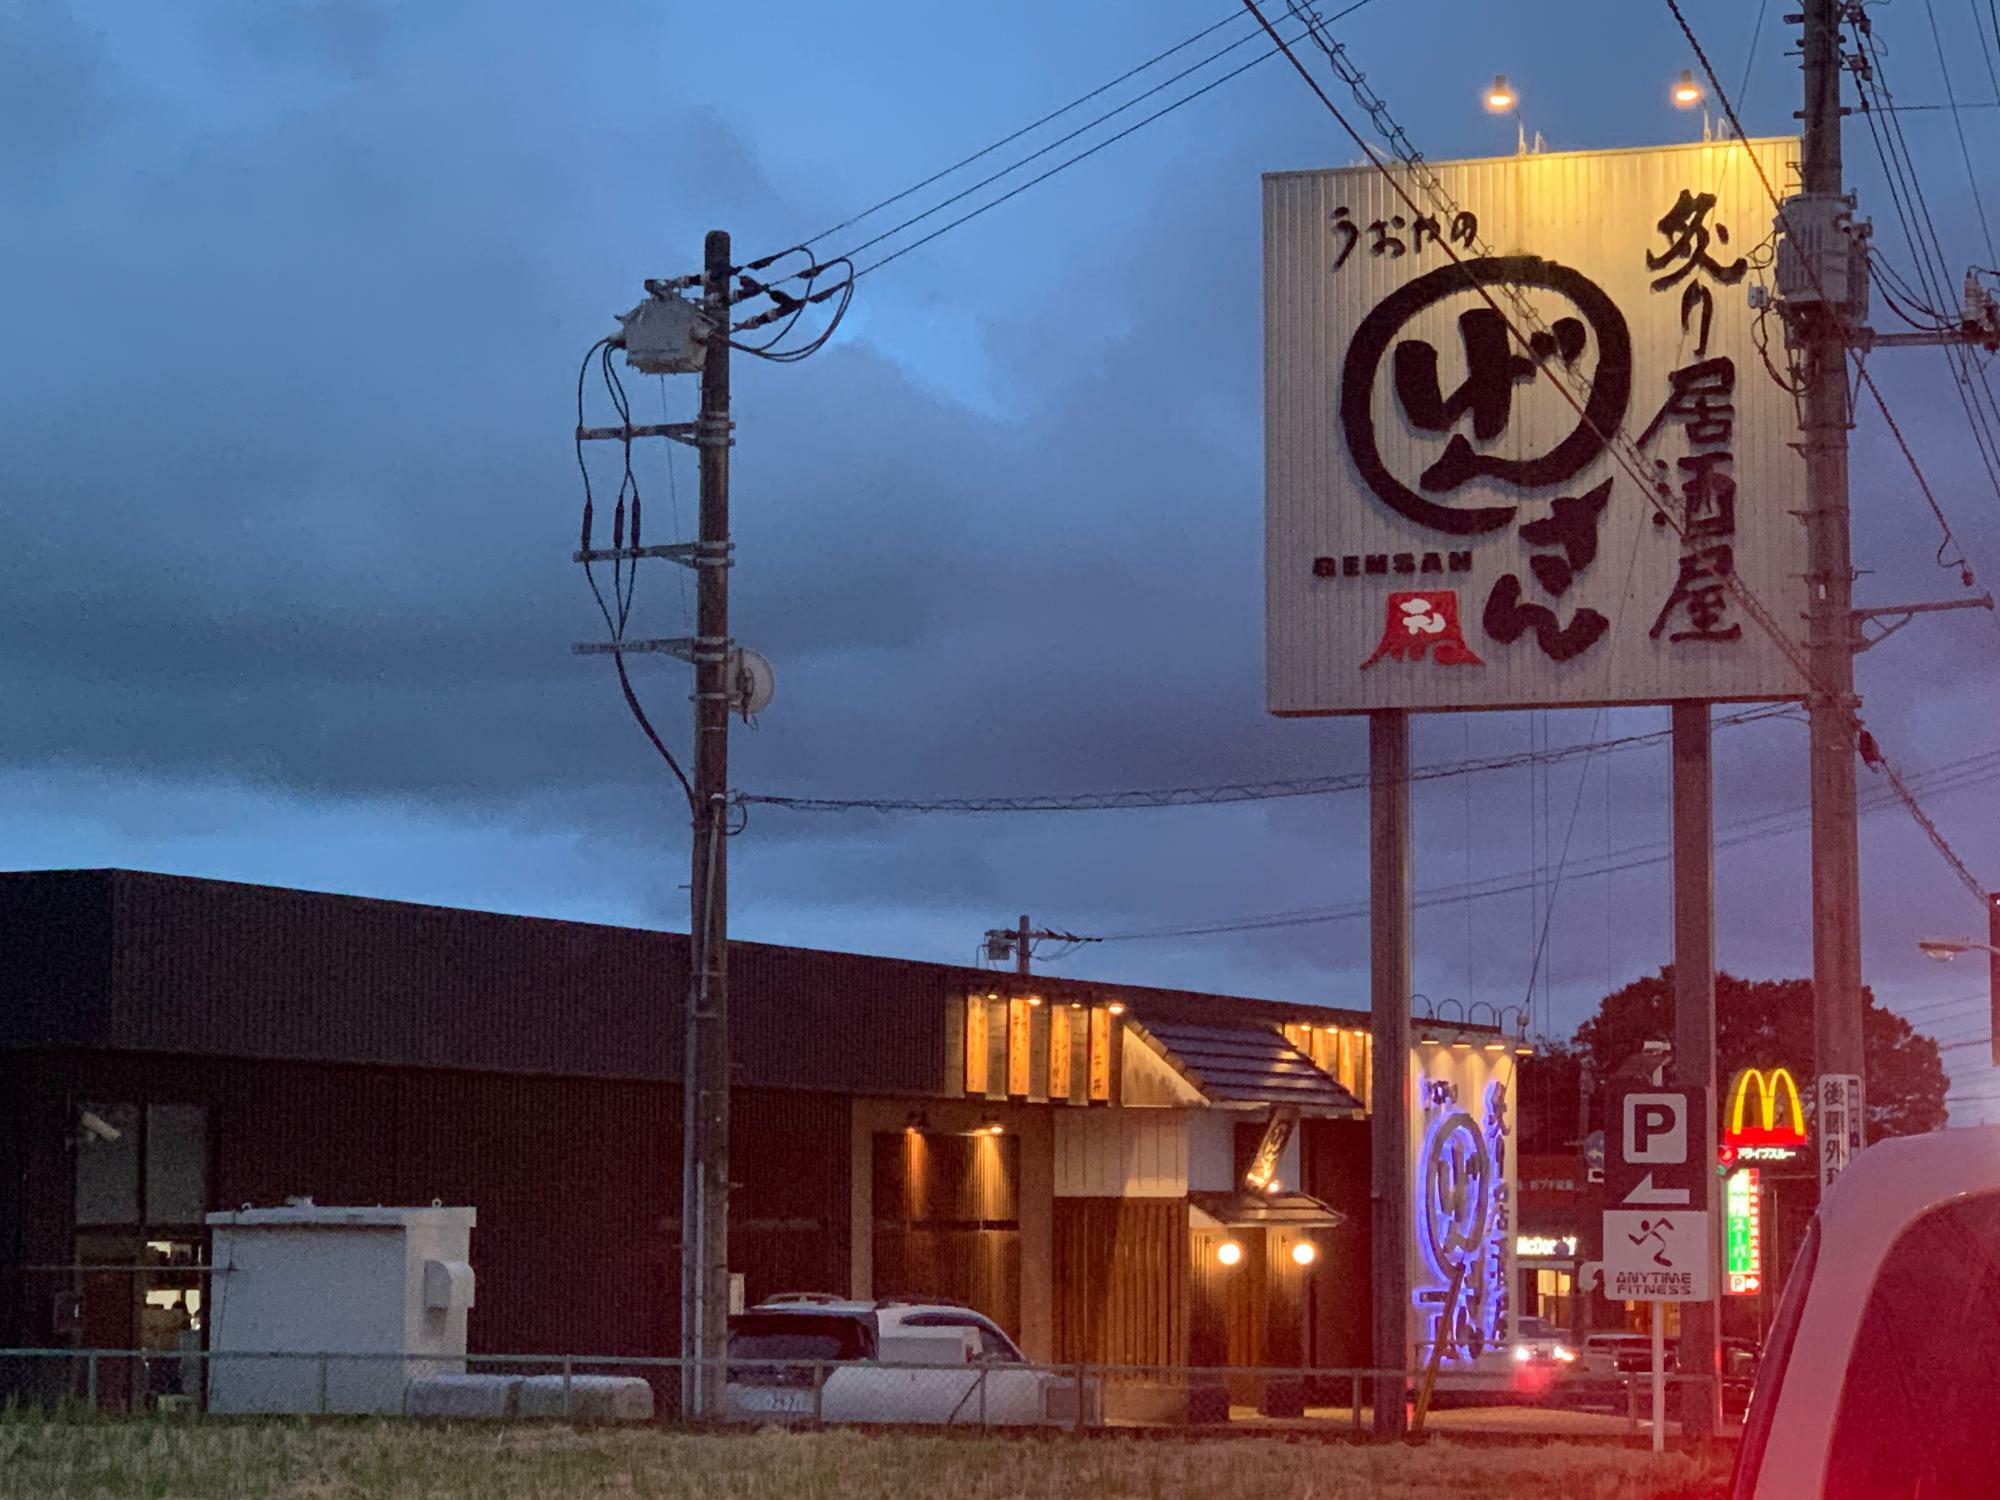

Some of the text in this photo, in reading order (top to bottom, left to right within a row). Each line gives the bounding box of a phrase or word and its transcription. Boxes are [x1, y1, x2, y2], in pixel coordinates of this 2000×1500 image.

[1637, 188, 1748, 642] 炙り居酒屋
[1634, 1104, 1676, 1153] P
[1737, 1147, 1797, 1161] ドライブスルー
[1616, 1271, 1692, 1284] ANYTIME
[1617, 1284, 1692, 1296] FITNESS
